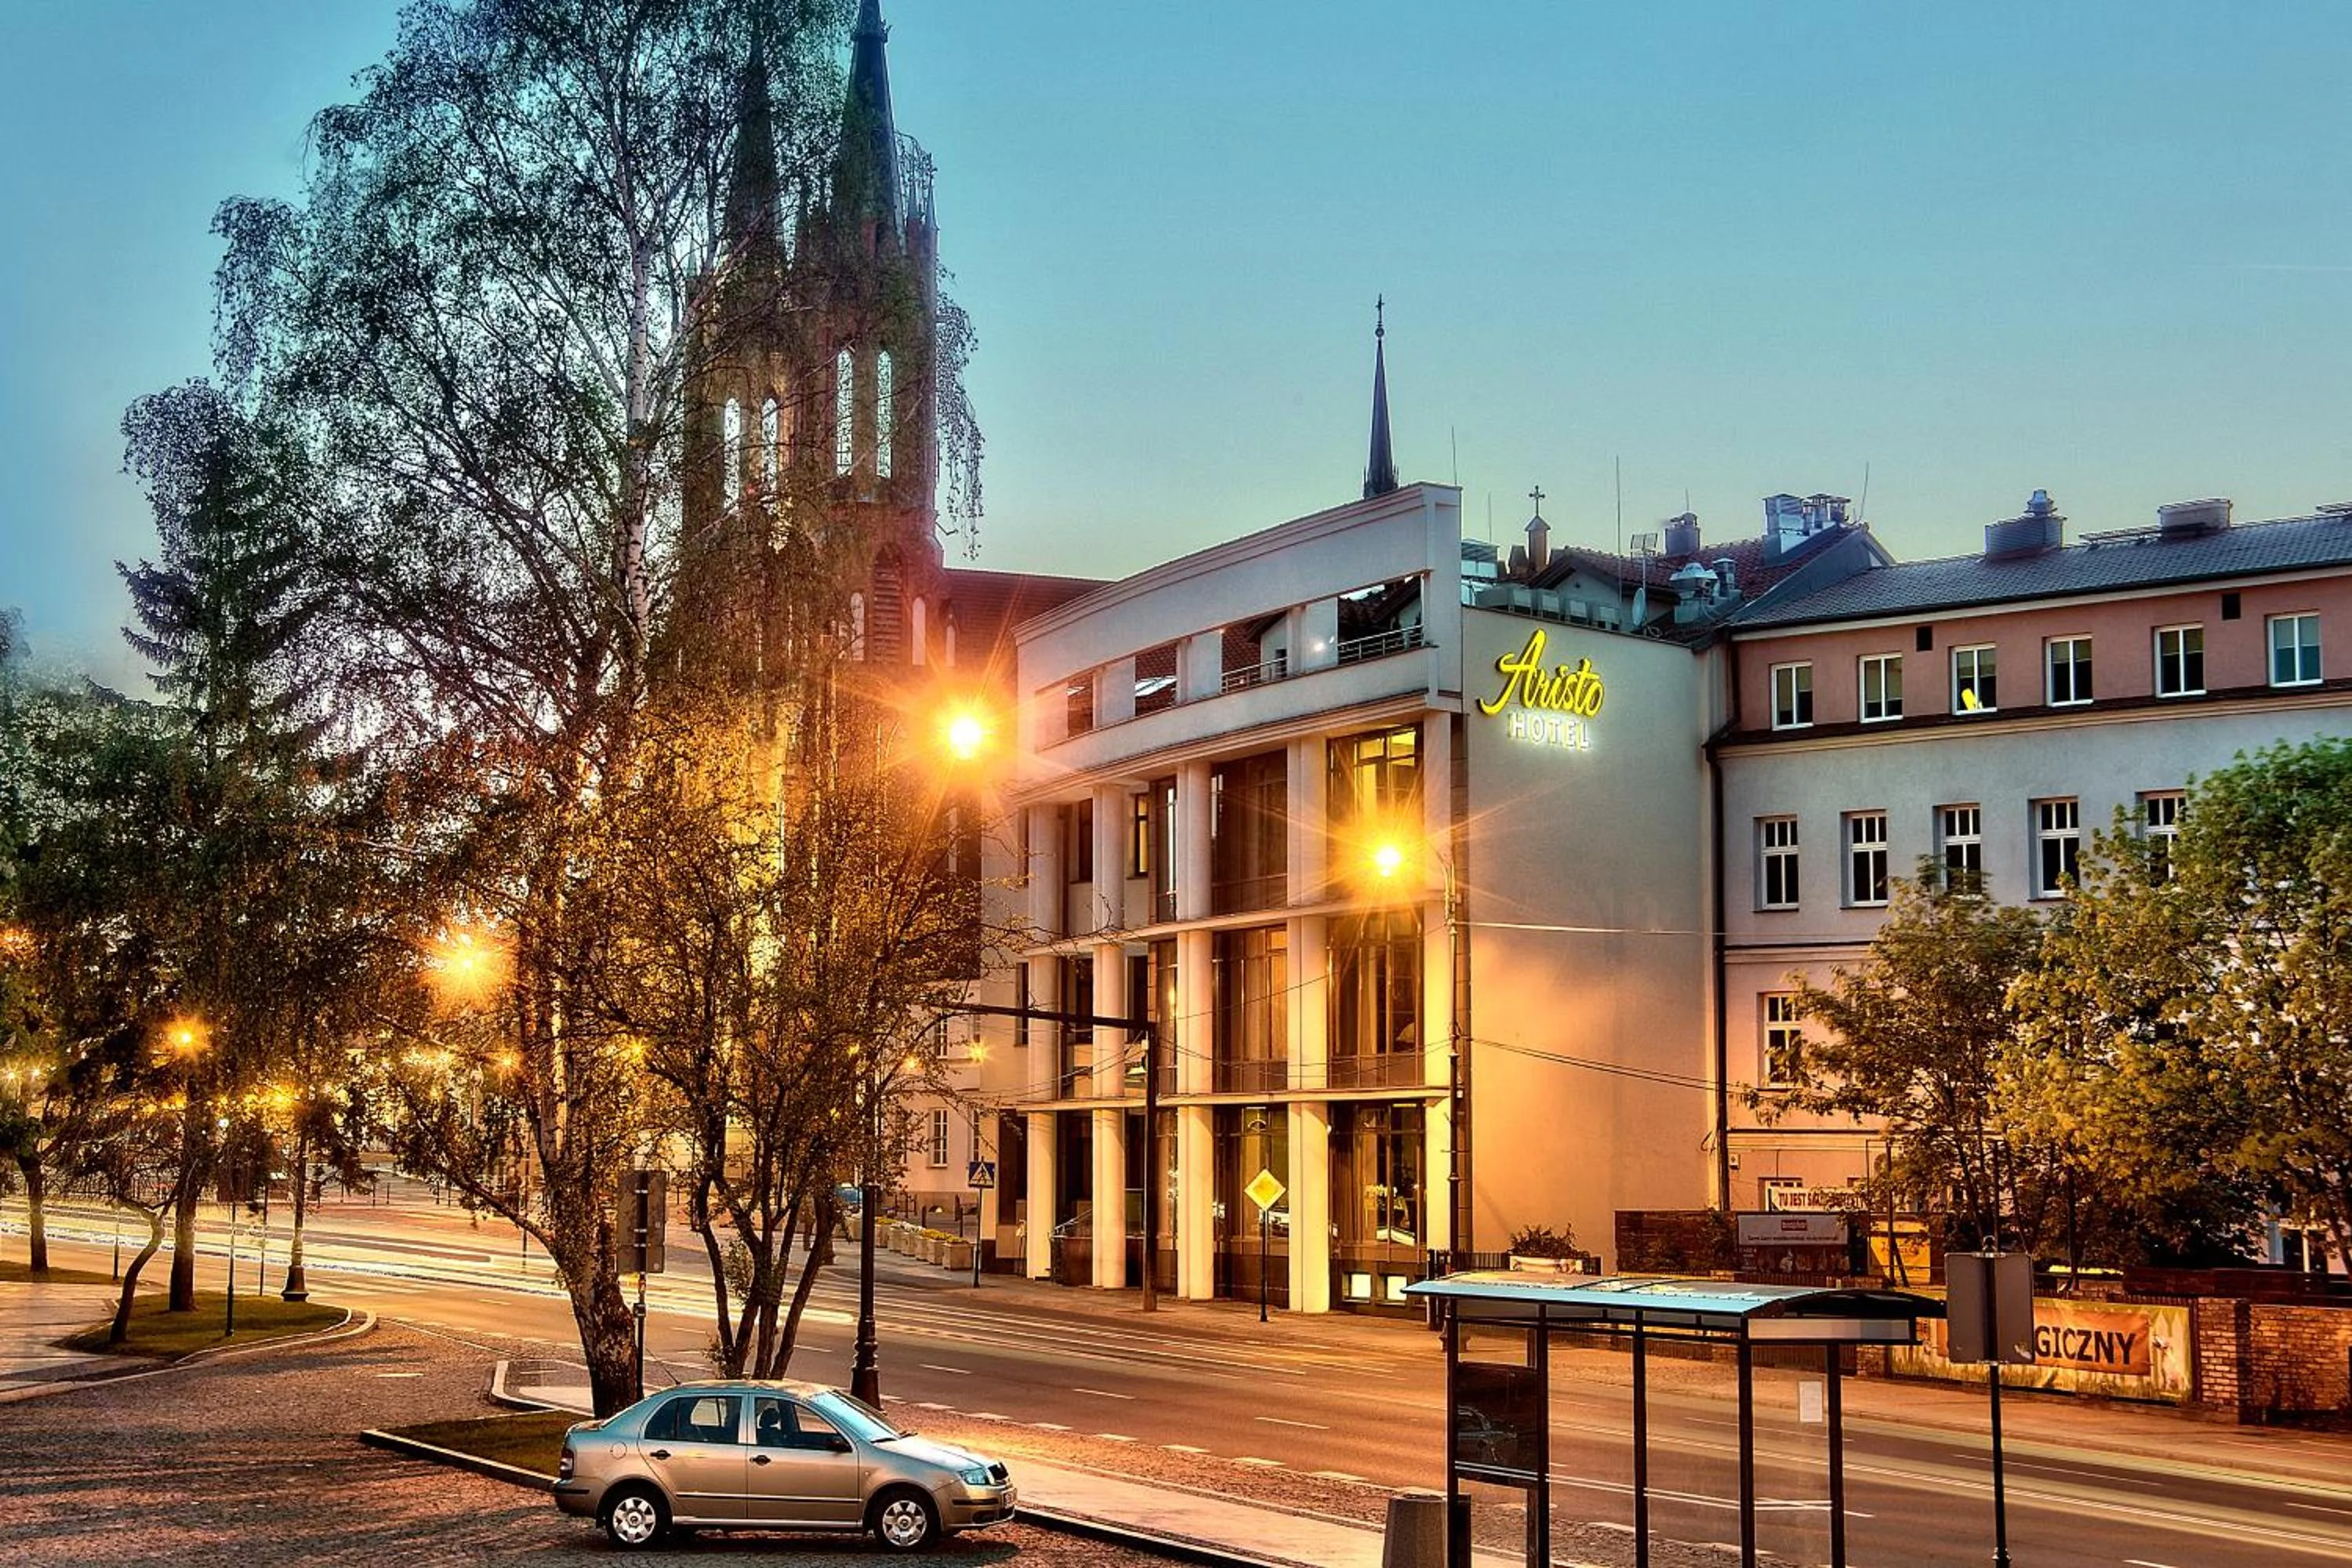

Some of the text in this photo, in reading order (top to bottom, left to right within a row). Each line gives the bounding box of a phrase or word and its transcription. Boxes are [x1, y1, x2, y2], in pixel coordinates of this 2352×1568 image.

[1478, 629, 1604, 717] Aristo
[1508, 710, 1591, 750] HOTEL
[2034, 1325, 2136, 1365] GICZNY
